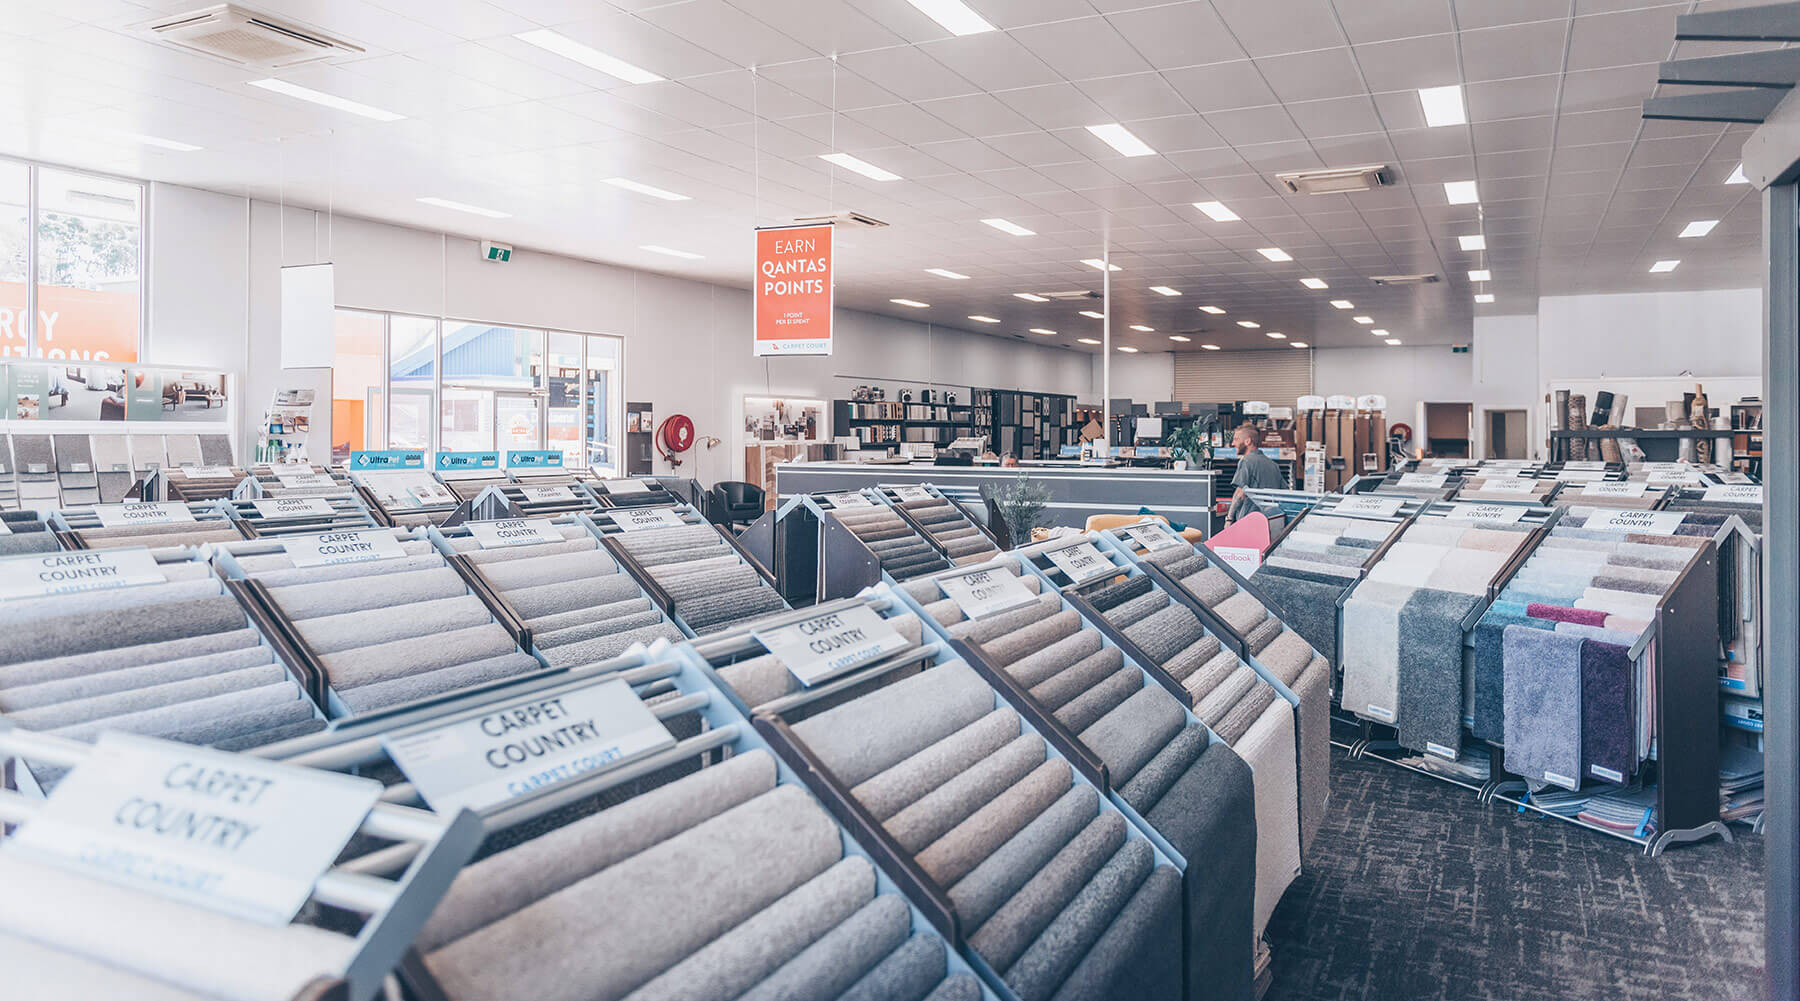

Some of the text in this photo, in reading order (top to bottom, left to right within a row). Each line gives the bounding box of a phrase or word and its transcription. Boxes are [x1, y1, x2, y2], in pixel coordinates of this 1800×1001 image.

[775, 238, 816, 254] EARN
[762, 257, 827, 278] QANTAS
[764, 279, 824, 296] POINTS
[123, 510, 169, 519] COUNTRY
[1609, 518, 1656, 527] COUNTRY
[1619, 511, 1655, 519] CARPET
[495, 520, 528, 529] CARPET
[496, 528, 539, 538] COUNTRY
[319, 533, 361, 544] CARPET
[318, 542, 374, 555] COUNTRY
[42, 553, 103, 568] CARPET
[39, 565, 118, 583] COUNTRY
[799, 614, 846, 636] CARPET
[809, 627, 867, 655] COUNTRY
[480, 698, 569, 738] CARPET
[485, 719, 601, 770] COUNTRY
[507, 746, 624, 797] CARPET COURT
[163, 761, 275, 805] CARPET
[114, 797, 261, 851] COUNTRY
